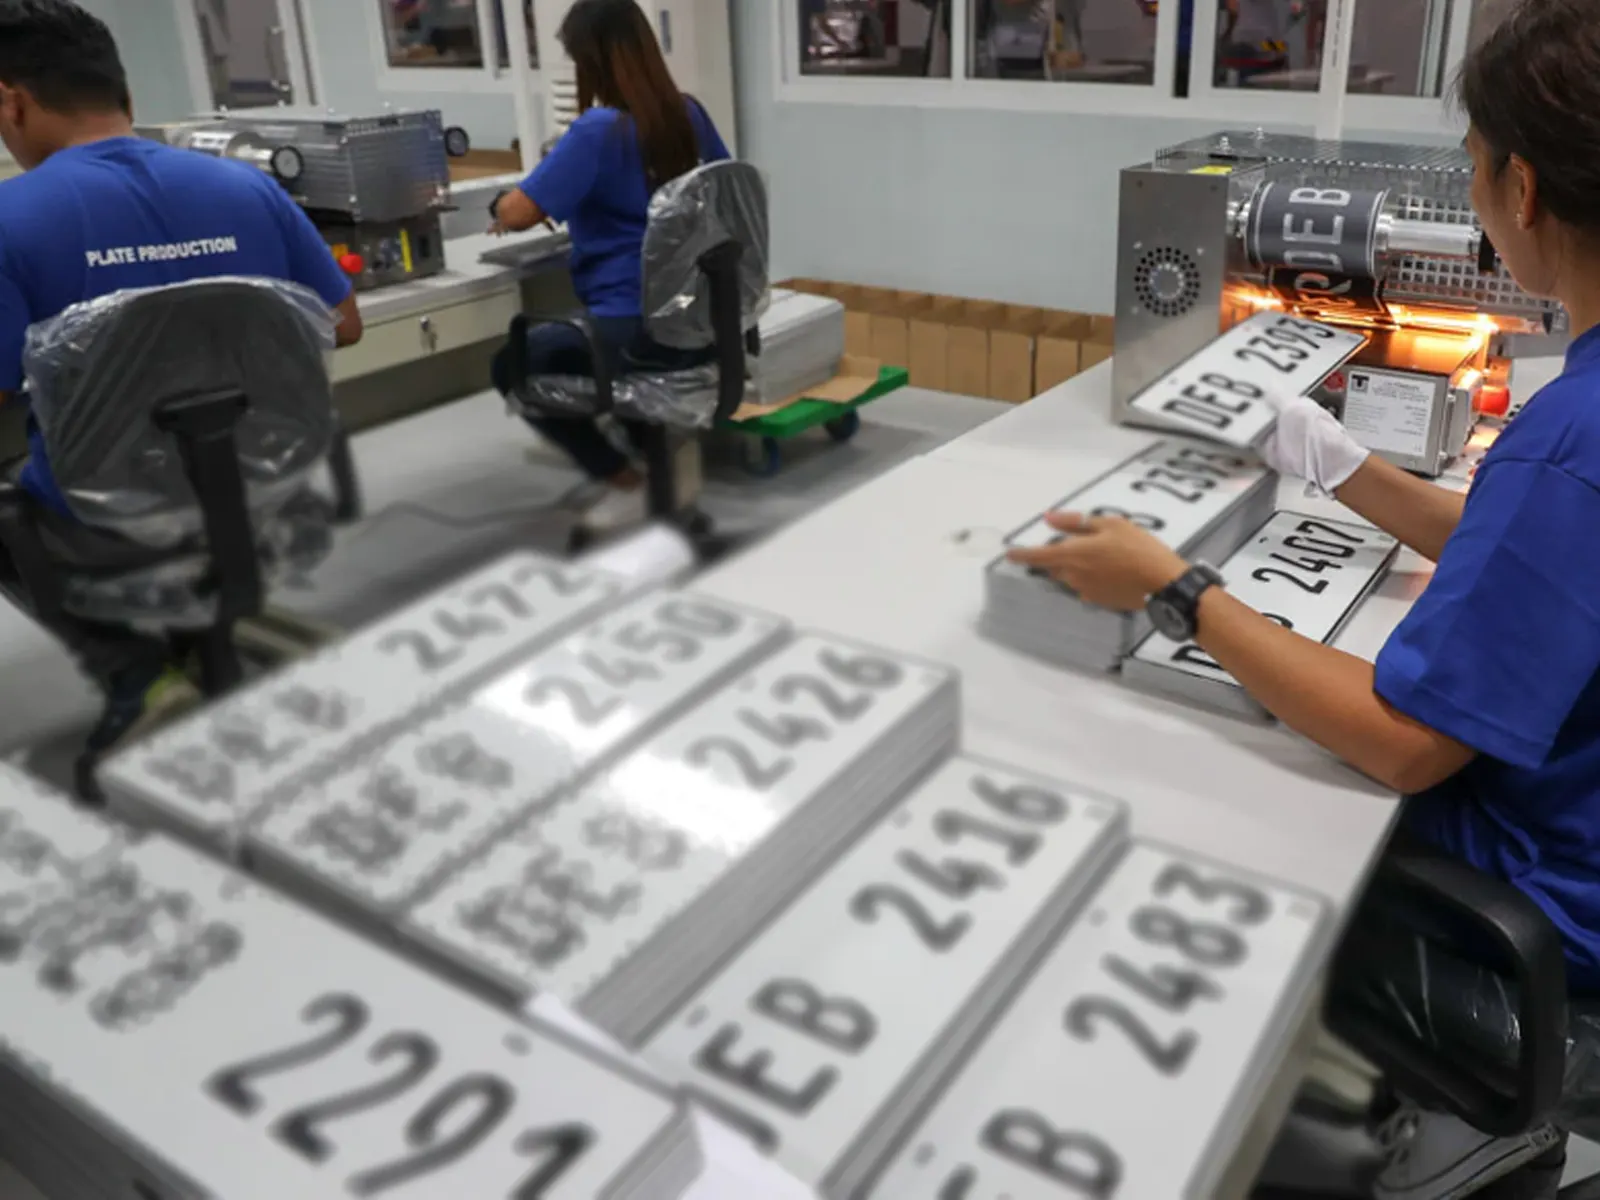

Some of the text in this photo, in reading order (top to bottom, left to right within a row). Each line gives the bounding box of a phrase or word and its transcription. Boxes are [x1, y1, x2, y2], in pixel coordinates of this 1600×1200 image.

[85, 235, 238, 268] PLATE PRODUCTION
[1282, 186, 1351, 272] DEB
[1161, 316, 1336, 430] DEB 2393
[375, 564, 597, 671] 2472
[1251, 519, 1365, 595] 2407
[521, 600, 743, 728] 2450
[682, 646, 904, 791] 2426
[846, 774, 1071, 954] 2416
[1061, 860, 1274, 1079] 2483
[201, 990, 600, 1200] 2291
